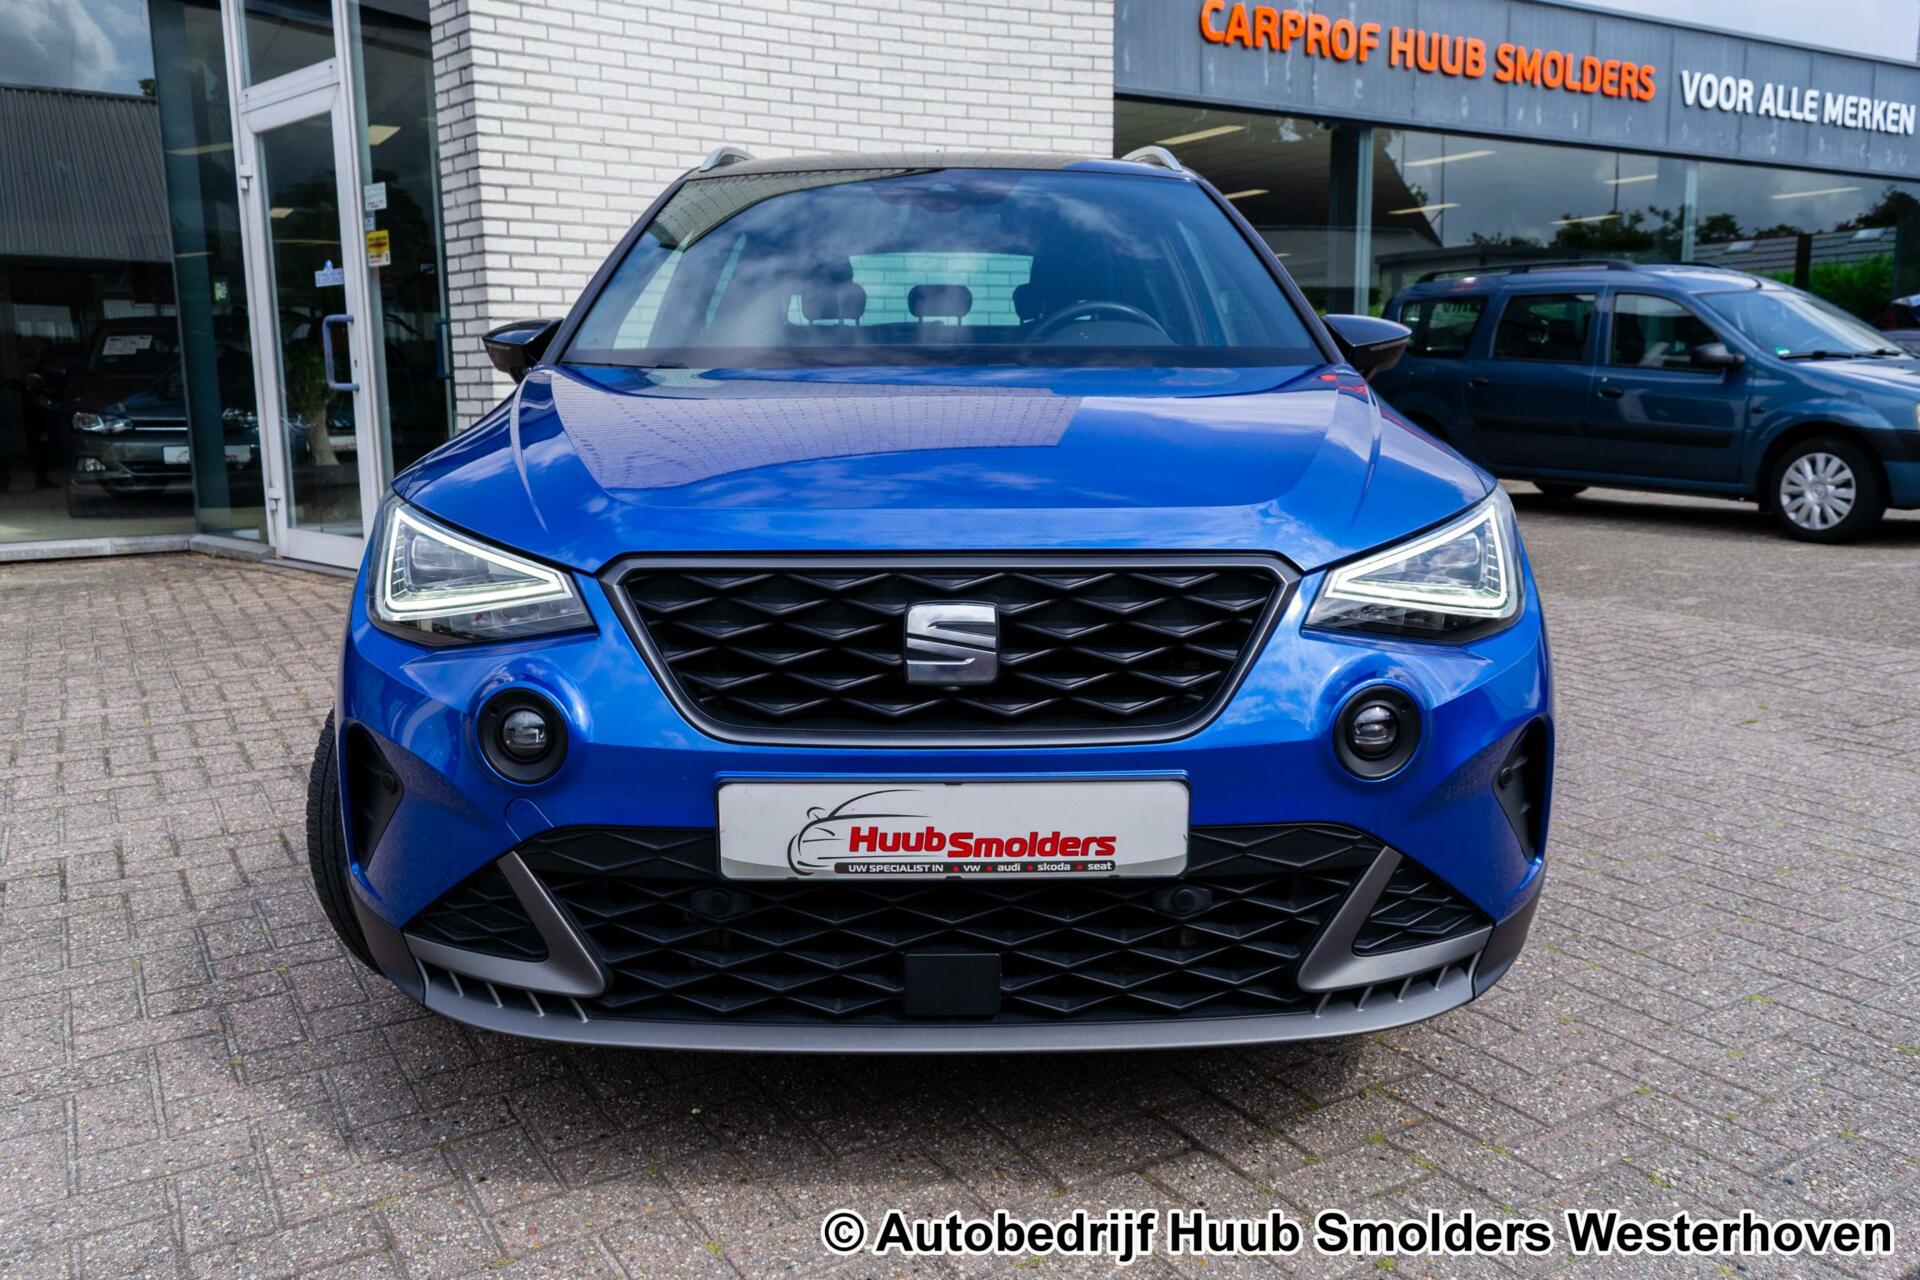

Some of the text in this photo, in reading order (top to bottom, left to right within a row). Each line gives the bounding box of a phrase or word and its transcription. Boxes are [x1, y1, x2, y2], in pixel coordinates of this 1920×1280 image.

[1200, 0, 1656, 101] CARPROF HUUB SMOLDERS
[1682, 70, 1916, 135] VOOR ALLE MERKEN
[848, 864, 868, 873] UW
[868, 863, 930, 873] SPECIALIST
[931, 863, 944, 872] IN
[997, 862, 1021, 872] audi
[1037, 862, 1071, 872] skoda
[1087, 861, 1113, 871] seat
